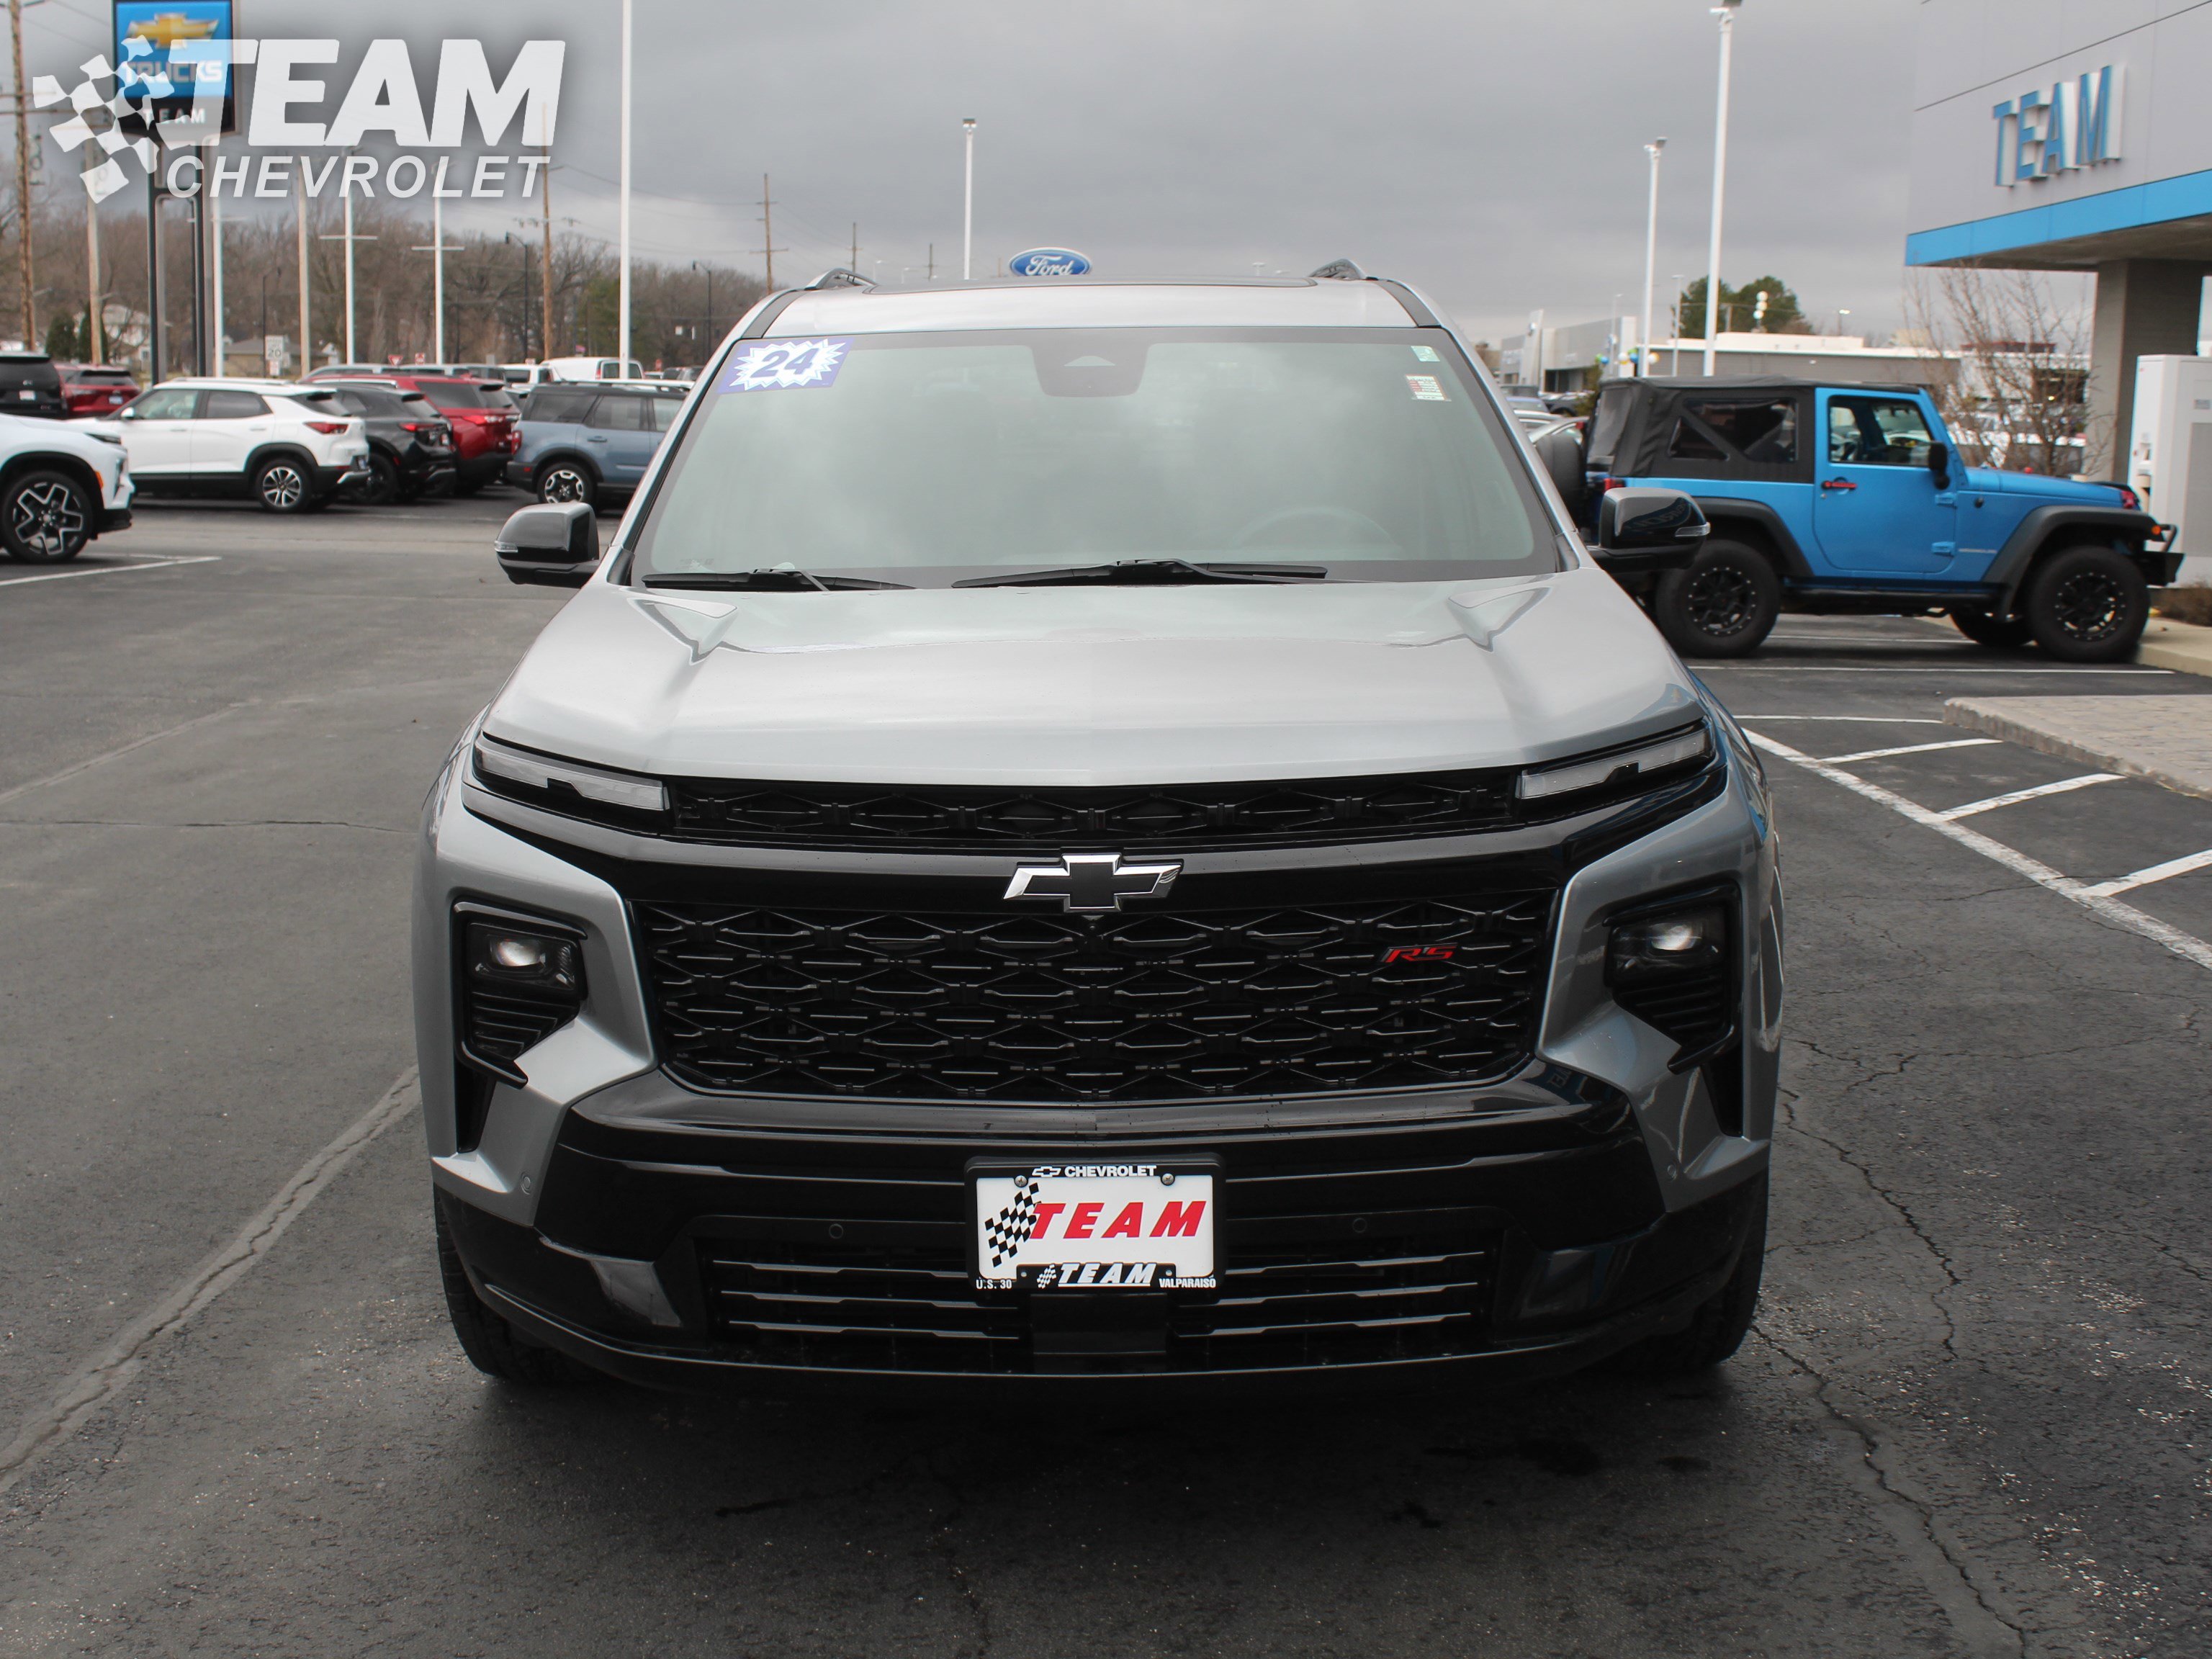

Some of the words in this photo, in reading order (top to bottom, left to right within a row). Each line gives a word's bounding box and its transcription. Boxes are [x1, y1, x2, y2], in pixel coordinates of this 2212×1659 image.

[124, 61, 222, 83] TRUCKS
[143, 108, 207, 124] TEAM
[1992, 65, 2125, 187] TEAM
[1025, 255, 1074, 276] Ford
[750, 348, 821, 378] 24
[1383, 945, 1457, 963] RS
[1064, 1165, 1157, 1177] CHEVROLET
[1029, 1201, 1207, 1239] TEAM
[976, 1279, 997, 1289] U.S.
[999, 1279, 1012, 1289] 30
[1058, 1263, 1156, 1284] TEAM
[1159, 1278, 1217, 1288] VALPARAISO
